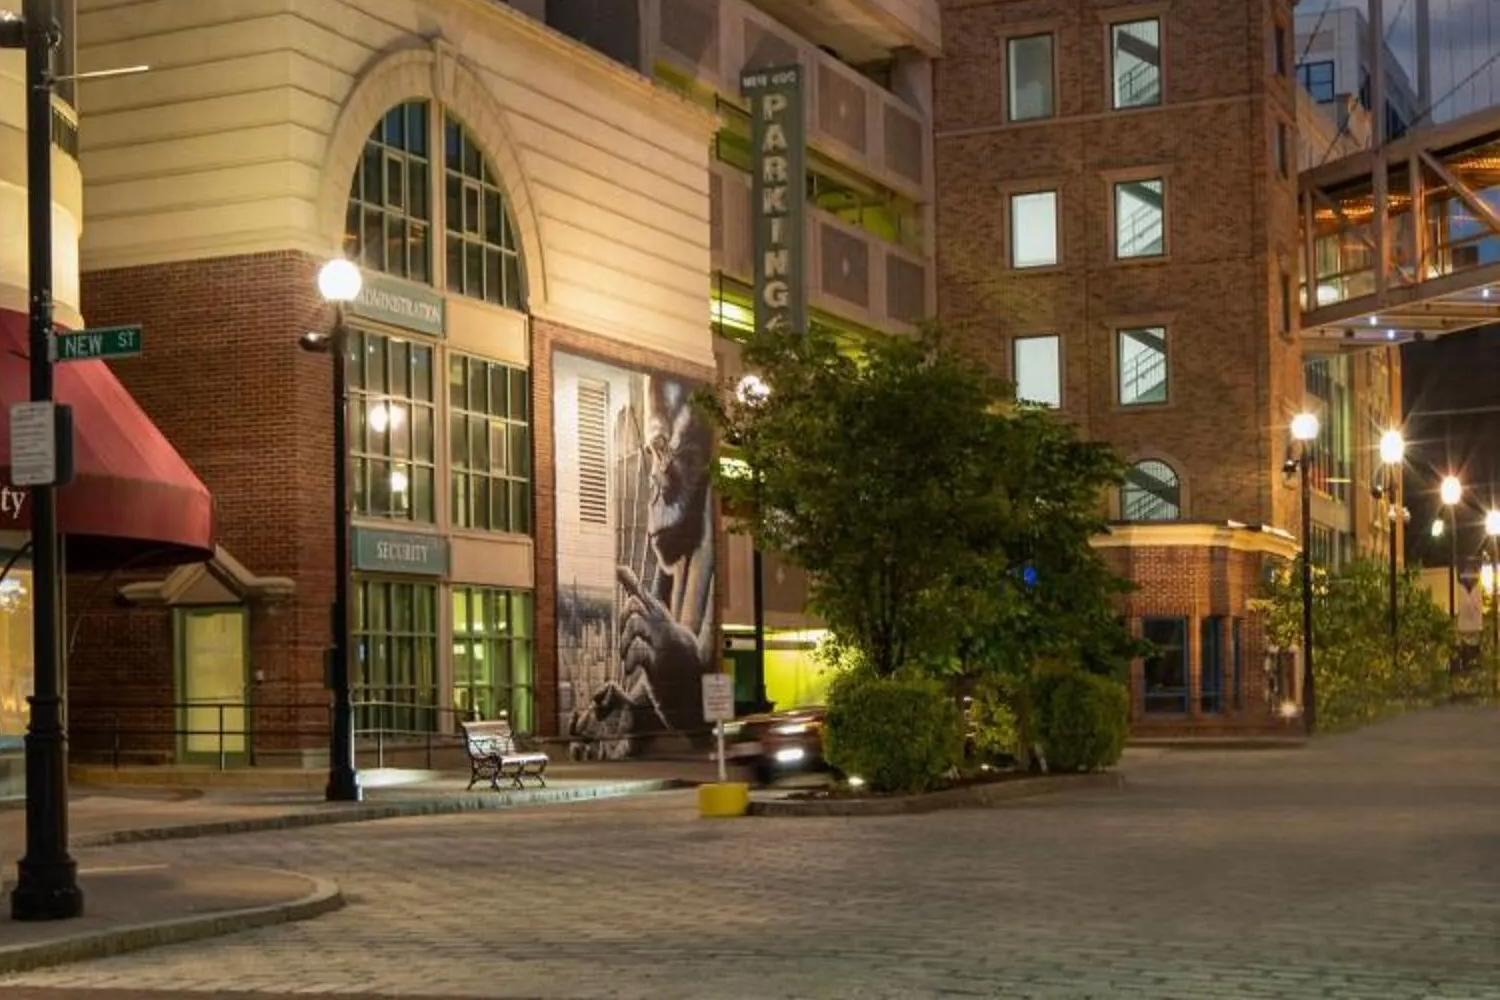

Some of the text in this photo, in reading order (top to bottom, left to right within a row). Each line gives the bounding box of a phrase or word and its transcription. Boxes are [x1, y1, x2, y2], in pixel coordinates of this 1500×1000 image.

[762, 93, 790, 308] PARKING
[65, 330, 135, 356] NEW ST
[376, 540, 429, 563] SECURITY
